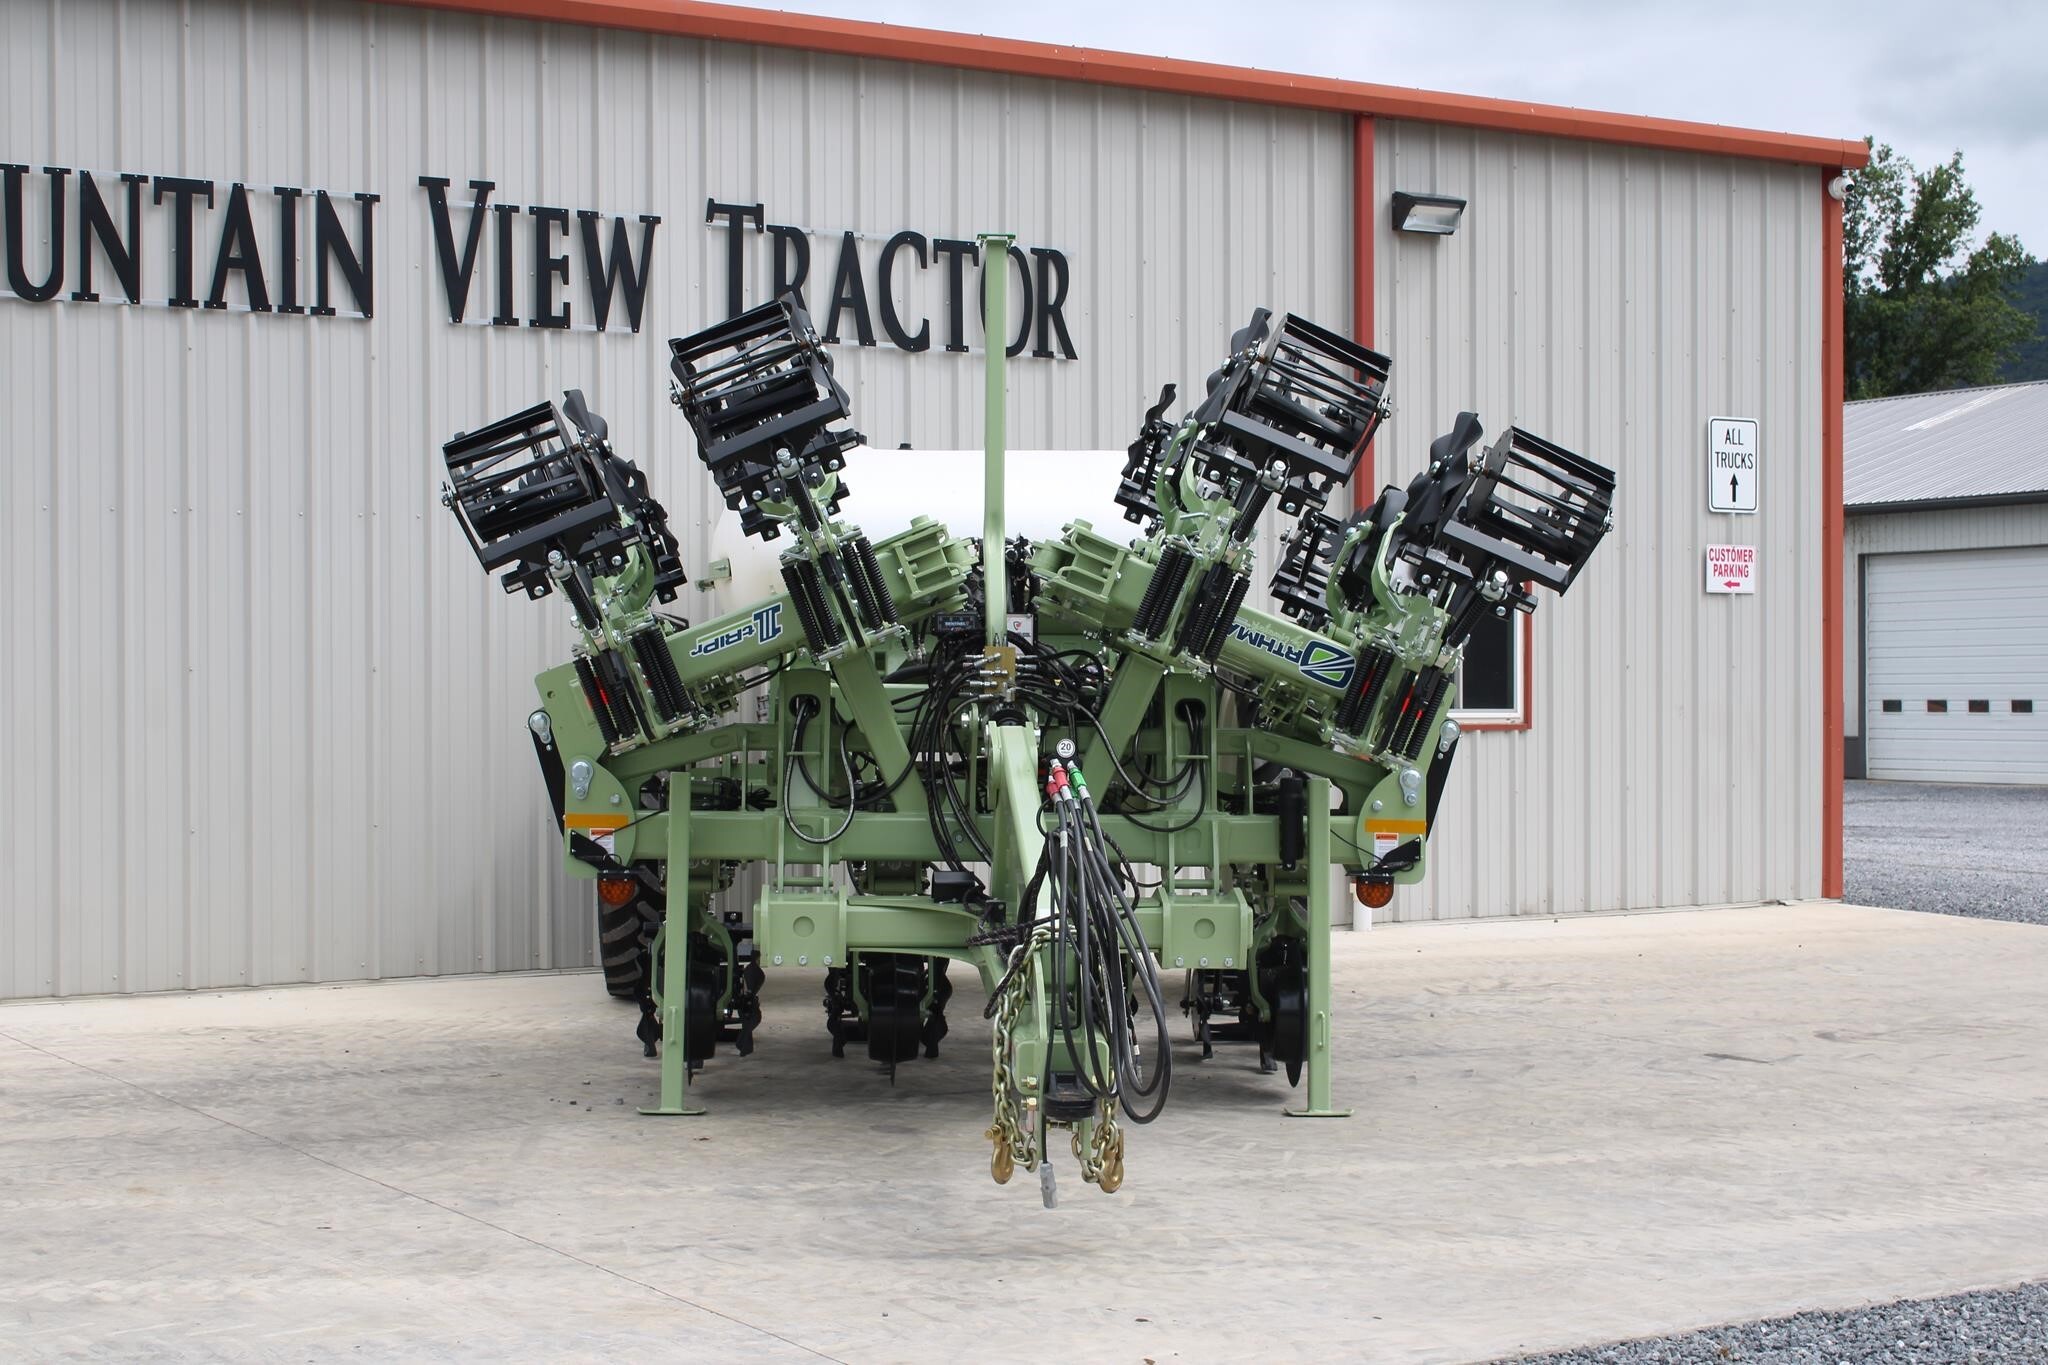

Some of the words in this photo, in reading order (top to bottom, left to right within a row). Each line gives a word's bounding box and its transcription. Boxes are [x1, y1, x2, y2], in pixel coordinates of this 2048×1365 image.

[0, 163, 380, 318] UNTAIN
[418, 176, 661, 333] VIEW
[705, 198, 1078, 361] TRACTOR
[1724, 428, 1744, 446] ALL
[1715, 451, 1754, 469] TRUCKS
[1708, 548, 1754, 563] CUSTOMER
[1713, 564, 1749, 578] PARKING
[1060, 742, 1071, 751] 20
